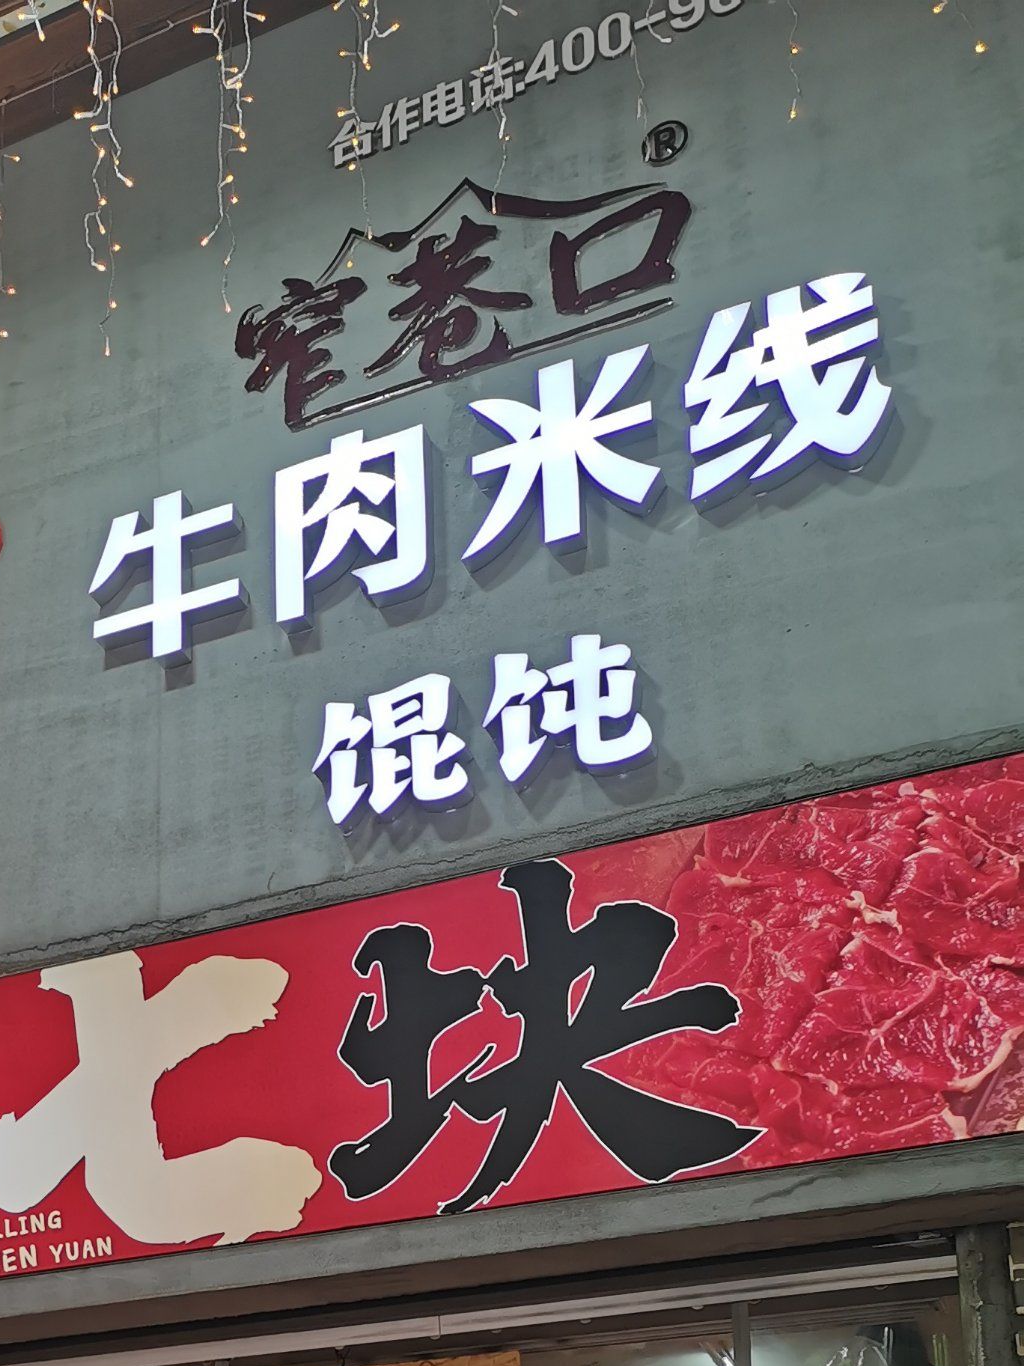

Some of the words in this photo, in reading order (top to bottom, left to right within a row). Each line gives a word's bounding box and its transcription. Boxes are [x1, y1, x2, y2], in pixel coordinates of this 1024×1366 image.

[91, 271, 893, 659] 牛肉米线
[312, 633, 655, 826] 馄饨
[49, 1236, 113, 1264] YUAN
